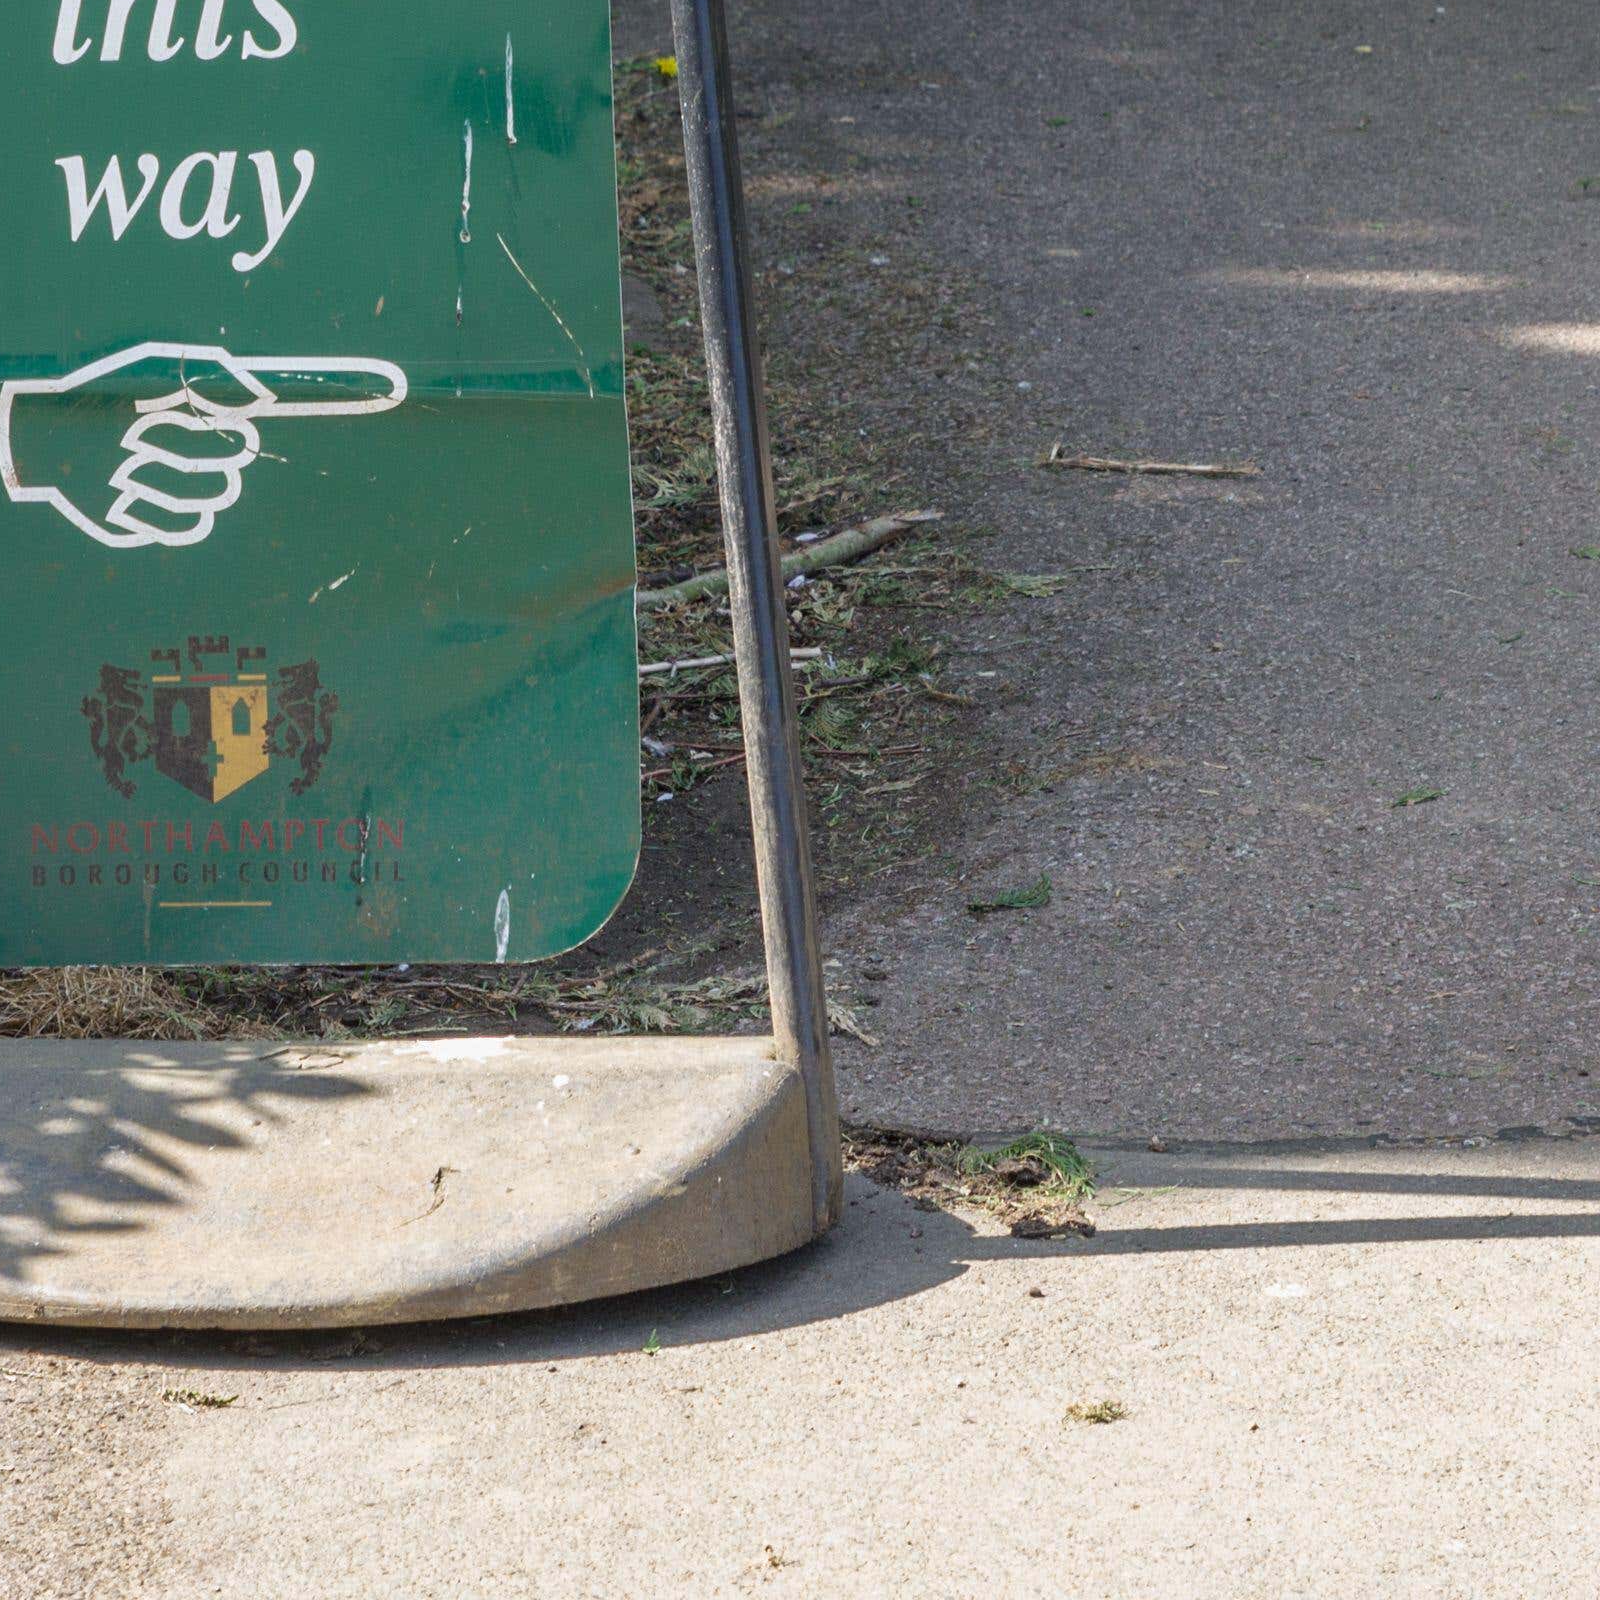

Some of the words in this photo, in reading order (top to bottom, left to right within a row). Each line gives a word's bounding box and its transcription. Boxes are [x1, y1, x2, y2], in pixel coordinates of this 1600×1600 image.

[54, 149, 315, 273] way
[31, 818, 404, 854] NORTHAMPTON
[32, 862, 218, 887] BOROUGH
[238, 860, 404, 884] COUNCIL
